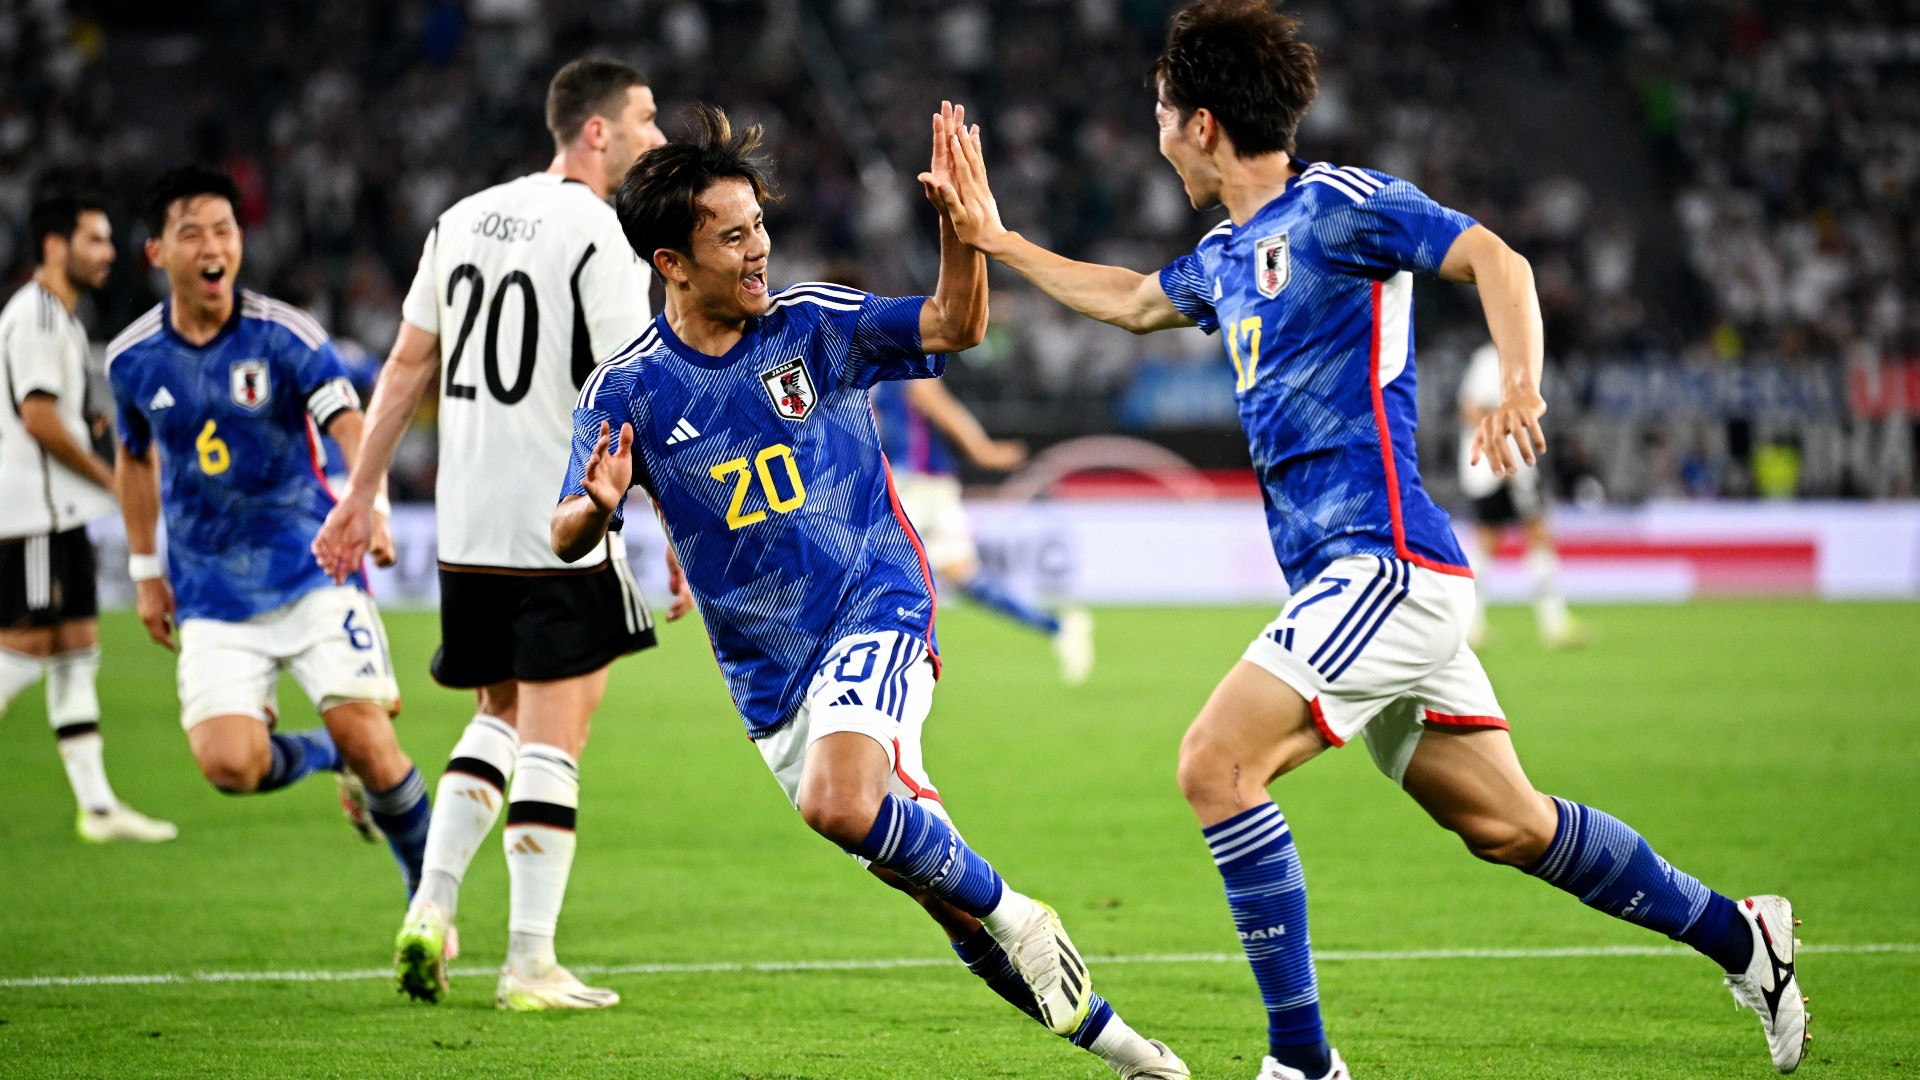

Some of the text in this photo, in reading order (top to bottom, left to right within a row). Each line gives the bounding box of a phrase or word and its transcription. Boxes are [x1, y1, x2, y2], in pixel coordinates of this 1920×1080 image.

[446, 263, 539, 405] 20
[1231, 316, 1262, 393] 17
[771, 363, 793, 376] JAPAN
[196, 418, 231, 476] 6
[709, 443, 807, 530] 20
[343, 609, 373, 650] 6
